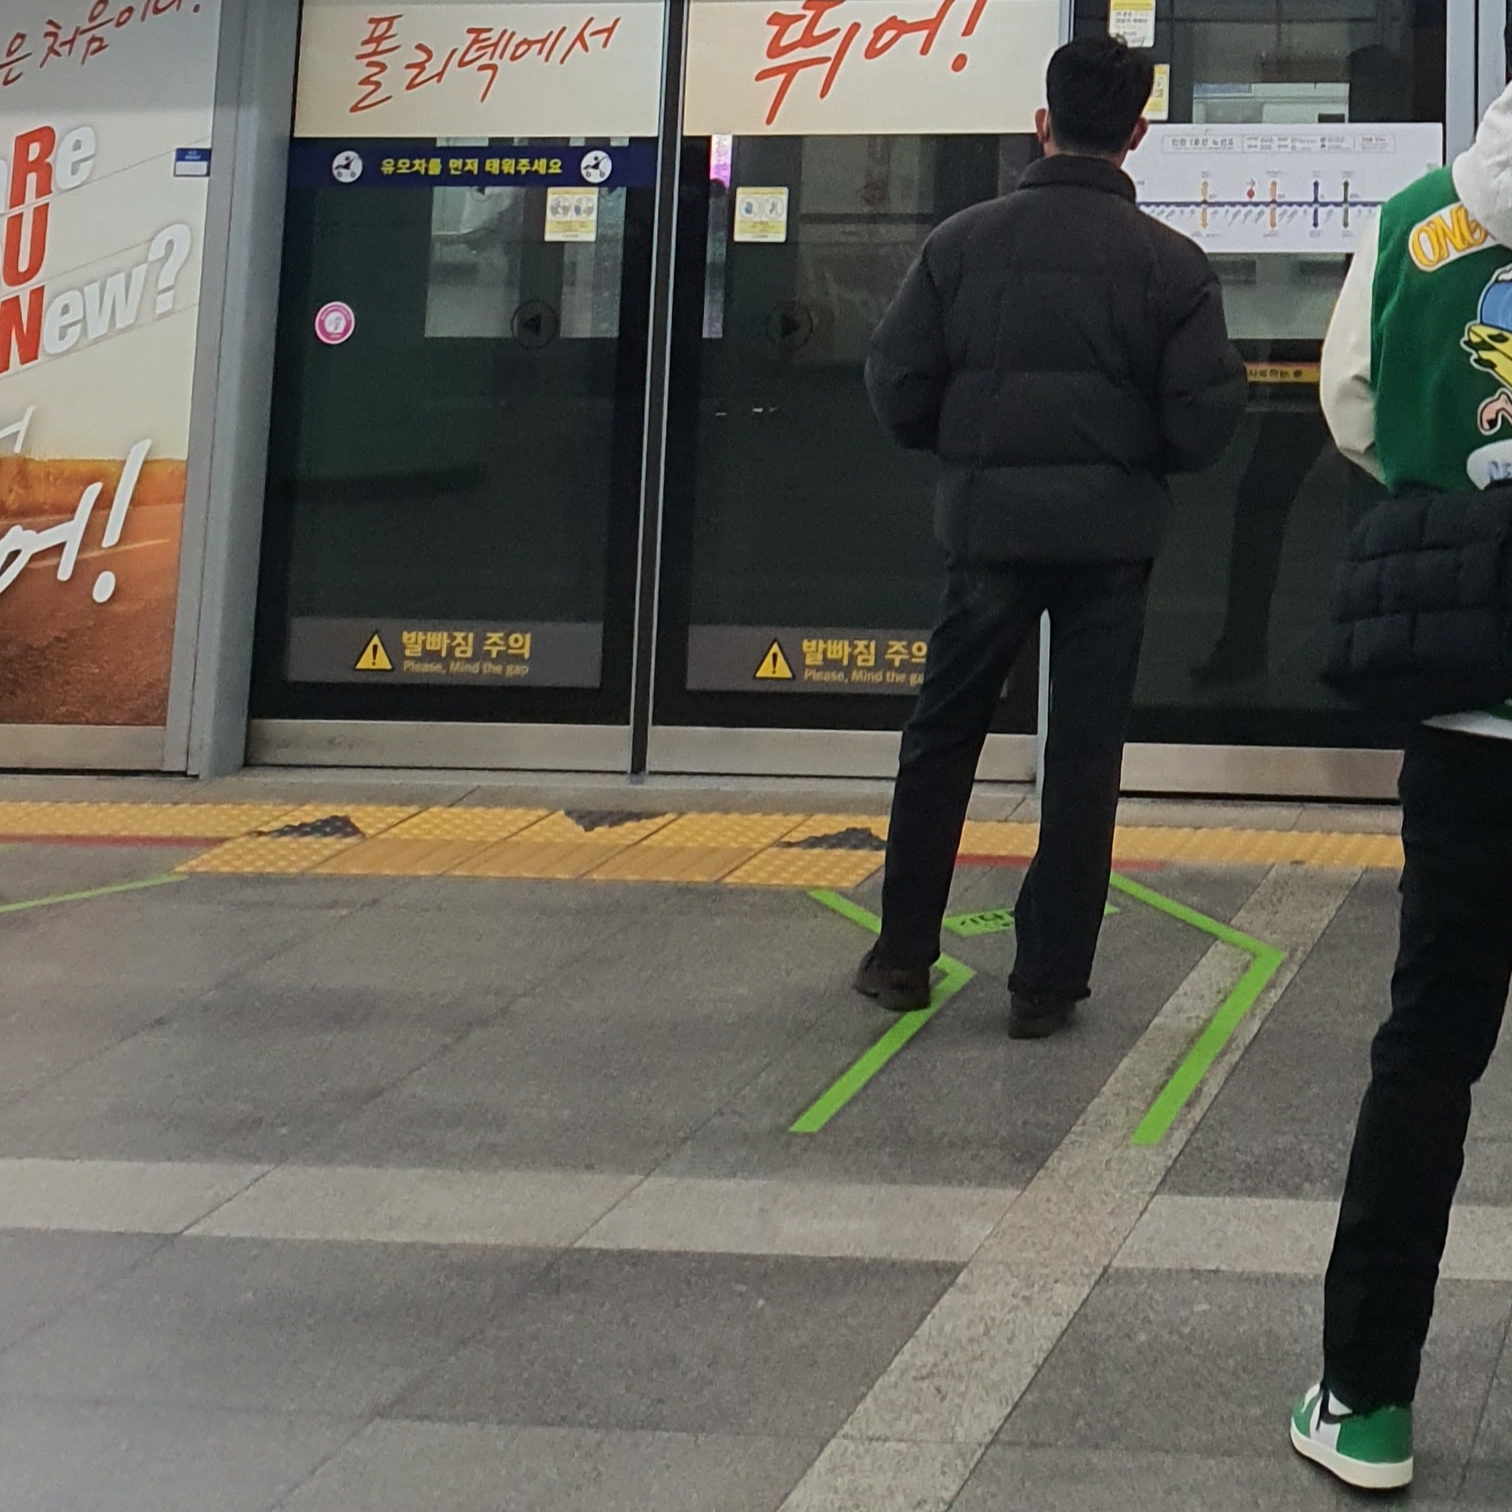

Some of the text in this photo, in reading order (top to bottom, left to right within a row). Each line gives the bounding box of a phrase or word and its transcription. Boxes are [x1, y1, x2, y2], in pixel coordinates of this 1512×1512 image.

[349, 14, 621, 113] 폴리텍에서
[381, 158, 562, 176] 유모차를 먼저 태워주세요
[0, 223, 192, 375] New?
[402, 630, 532, 659] 발빠짐 주의
[802, 638, 876, 667] 발빠짐
[403, 660, 530, 678] Please, Mind the gap
[803, 668, 848, 683] Please,
[851, 669, 883, 684] Mind
[885, 669, 906, 684] the
